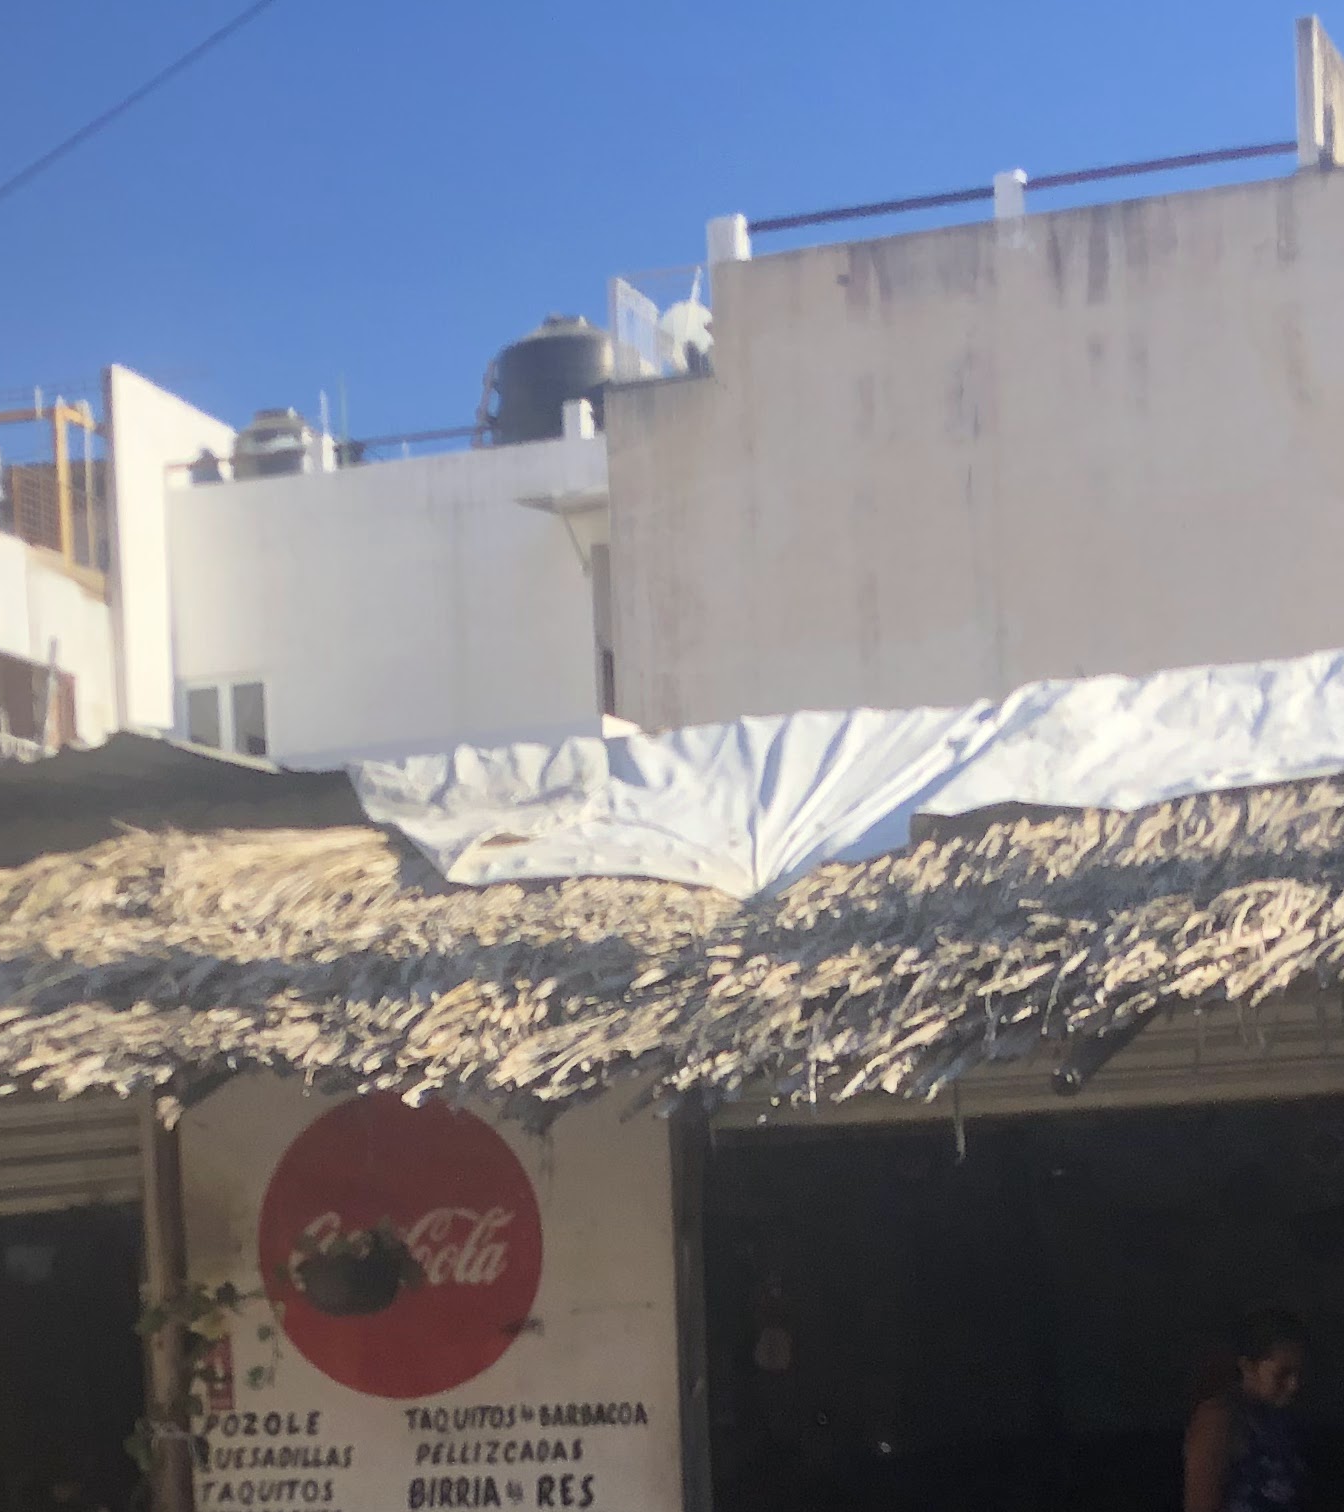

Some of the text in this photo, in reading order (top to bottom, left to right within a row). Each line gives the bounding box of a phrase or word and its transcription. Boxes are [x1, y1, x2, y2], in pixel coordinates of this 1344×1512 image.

[205, 1410, 321, 1437] POZOLE
[404, 1405, 517, 1432] TAQUITOS
[539, 1402, 648, 1427] BARBACOA
[197, 1444, 354, 1472] UESADILLAS
[415, 1438, 583, 1465] PELLIZCADAS
[202, 1479, 333, 1505] TAQUITOS
[408, 1475, 502, 1509] BIRRIA
[536, 1473, 594, 1508] RES
